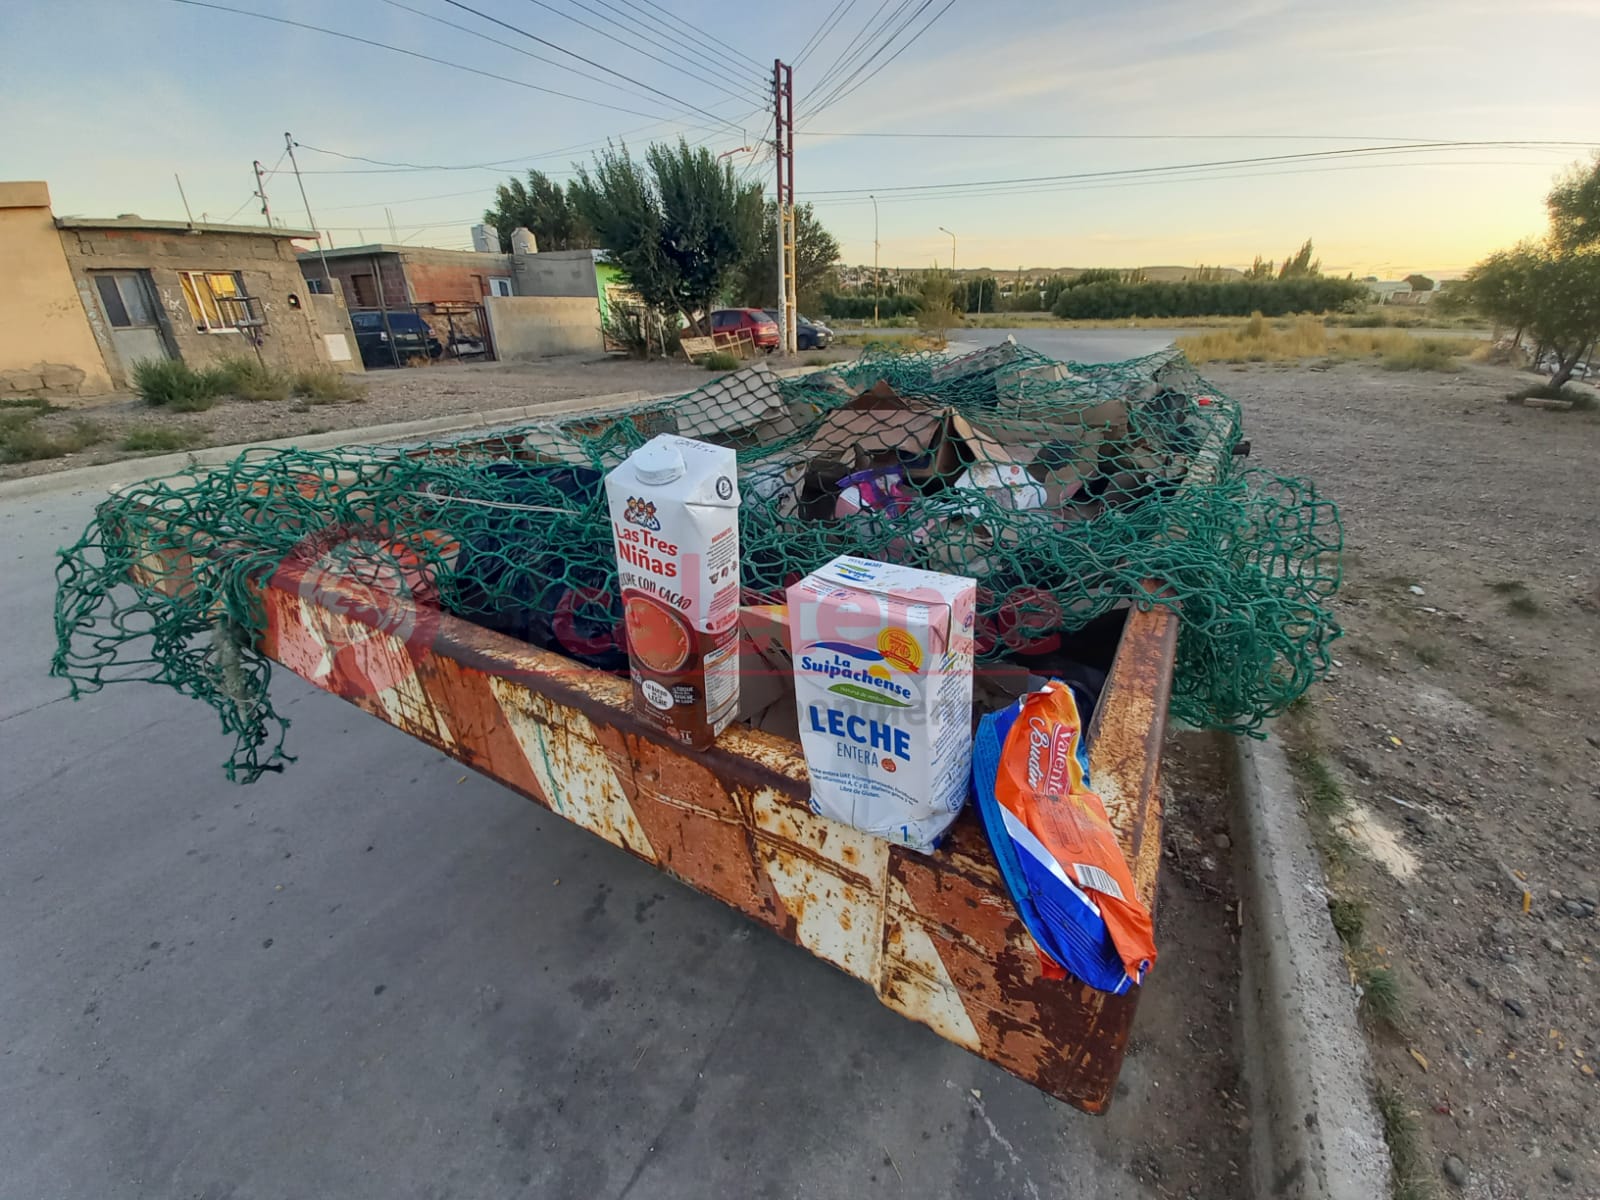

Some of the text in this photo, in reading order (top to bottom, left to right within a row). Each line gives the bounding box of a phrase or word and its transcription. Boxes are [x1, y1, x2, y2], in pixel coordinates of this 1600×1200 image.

[615, 522, 639, 543] Las
[640, 529, 678, 557] Tres
[618, 540, 677, 577] Niñas
[659, 586, 692, 610] CACAO
[834, 655, 850, 668] La
[801, 656, 911, 699] Suipachense
[809, 706, 910, 761] LECHE
[837, 742, 879, 769] ENTERA
[900, 825, 908, 841] 1
